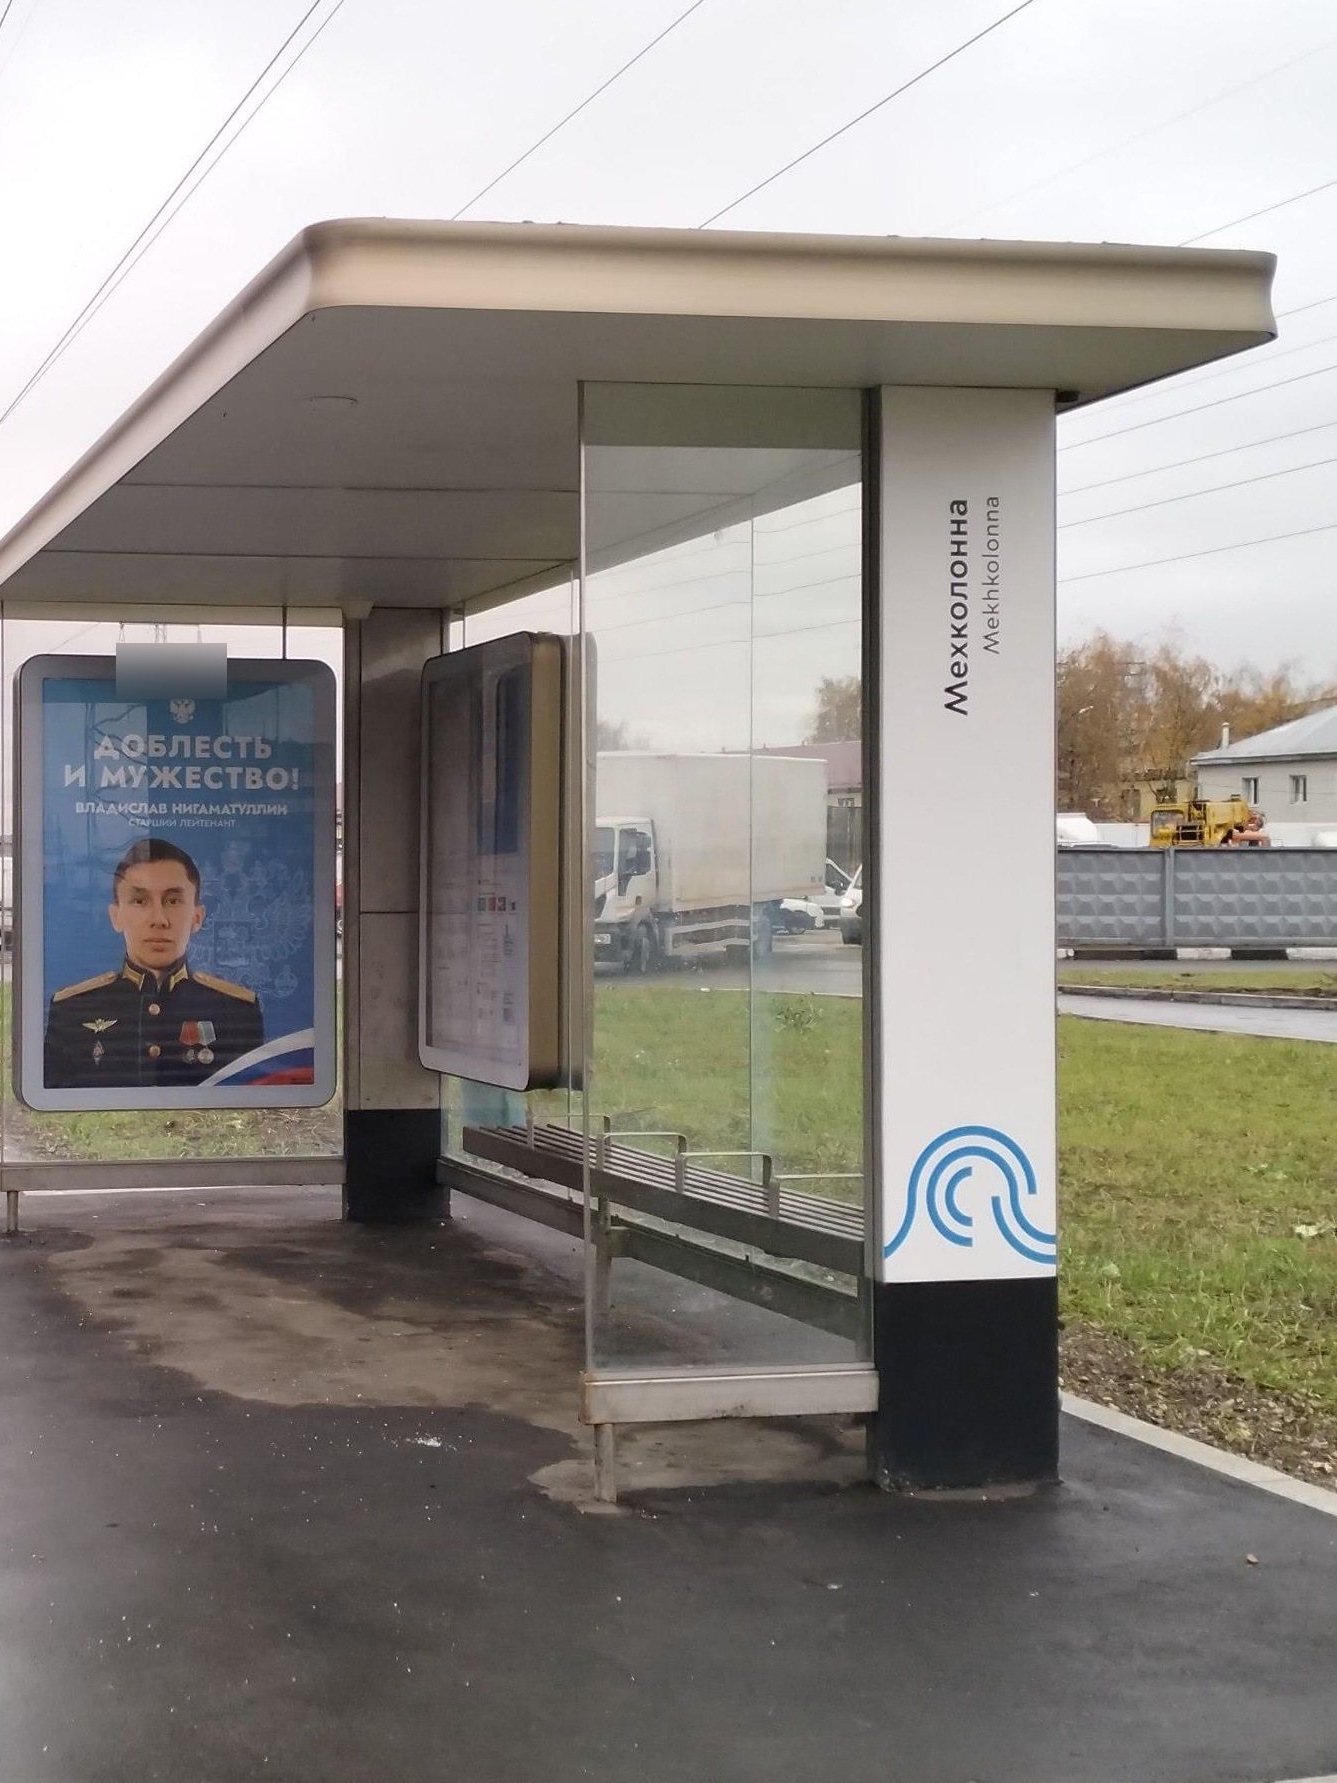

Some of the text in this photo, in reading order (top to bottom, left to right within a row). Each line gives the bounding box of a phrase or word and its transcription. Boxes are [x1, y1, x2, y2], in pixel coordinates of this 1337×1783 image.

[981, 496, 1001, 655] Mekhkolonna
[943, 499, 969, 716] Мехколонна
[94, 734, 272, 760] ДОБЛЕСТЬ
[65, 764, 299, 790] И МУЖЕСТВО!
[75, 802, 288, 816] ВЛАДИСЛАВ НИГАМАТУЛЛИН
[180, 817, 236, 828] ЛЕЙТЕНАНТ
